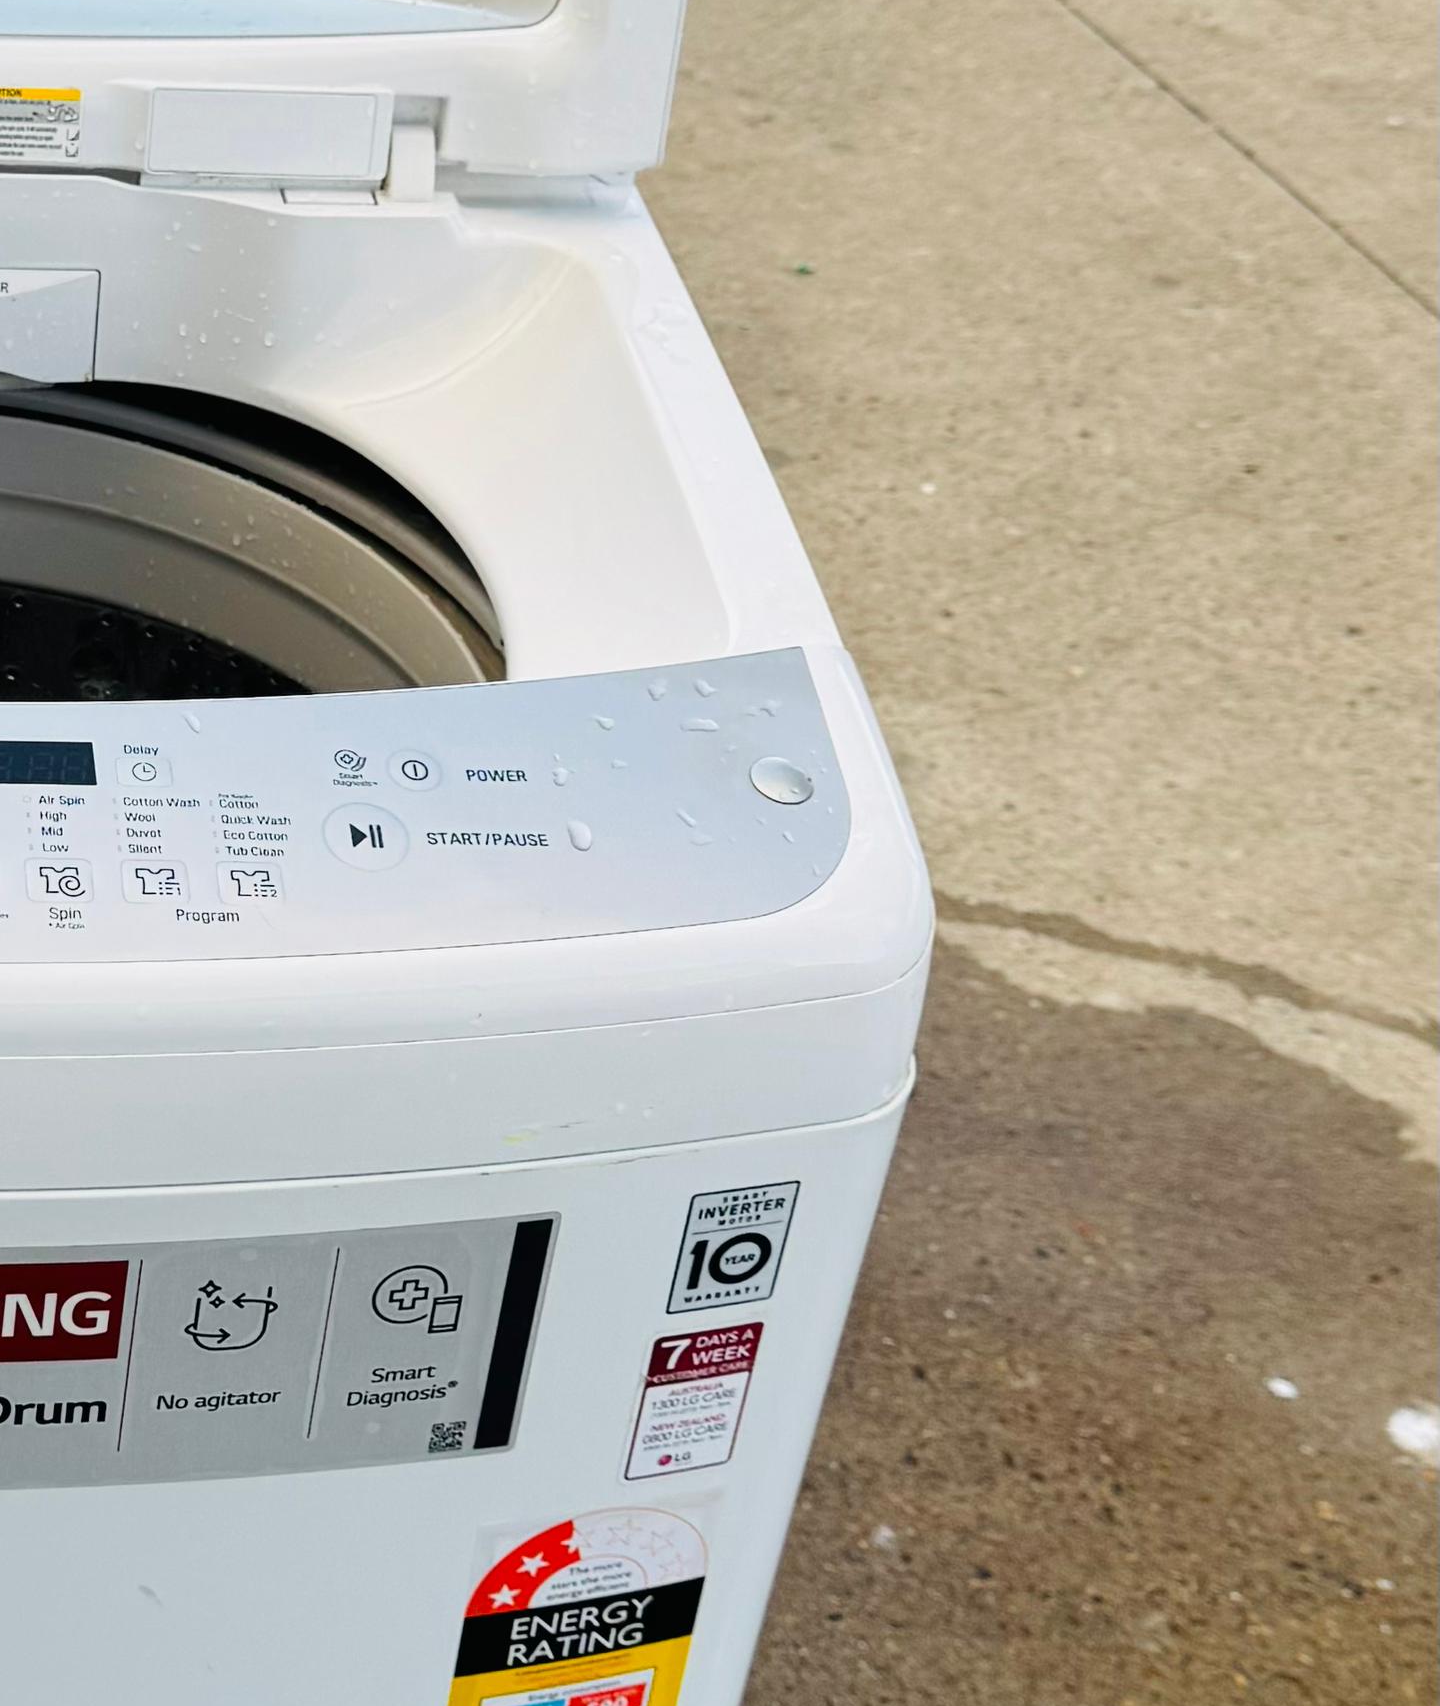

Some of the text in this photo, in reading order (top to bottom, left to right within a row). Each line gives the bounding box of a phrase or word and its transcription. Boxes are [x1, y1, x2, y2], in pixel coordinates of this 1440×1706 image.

[123, 745, 159, 755] Delay
[466, 769, 527, 782] POWER
[39, 796, 85, 806] Air Spin
[123, 797, 200, 807] Cotton Wash
[219, 800, 258, 809] Cotton
[40, 812, 66, 822] High
[125, 813, 156, 821] Wool
[221, 815, 291, 825] Quick Wash
[42, 827, 63, 836] Mid
[223, 831, 288, 841] Eco Cotton
[427, 832, 549, 847] START/PAUSE
[43, 843, 69, 852] Low
[129, 844, 162, 854] Silent
[225, 846, 284, 857] Tub Clean
[49, 907, 81, 921] Spin
[176, 909, 240, 924] Program
[723, 1191, 768, 1203] SMART
[698, 1198, 785, 1220] INVERTER
[718, 1215, 761, 1225] MOTOR
[686, 1233, 772, 1290] 10
[725, 1253, 756, 1265] YEAR
[684, 1286, 760, 1303] WARRANTY
[696, 1329, 755, 1348] DAYS A
[661, 1338, 692, 1370] 7
[692, 1343, 751, 1365] WEEK
[371, 1365, 436, 1384] Smart
[653, 1361, 749, 1383] CUSTOMER CARE
[157, 1387, 282, 1412] No agitator
[702, 1388, 737, 1402] CARE
[694, 1423, 728, 1435] CARE
[674, 1451, 691, 1461] LG
[593, 1562, 622, 1571] more
[603, 1572, 632, 1581] more
[510, 1595, 655, 1641] ENERGY
[507, 1622, 645, 1666] RATING
